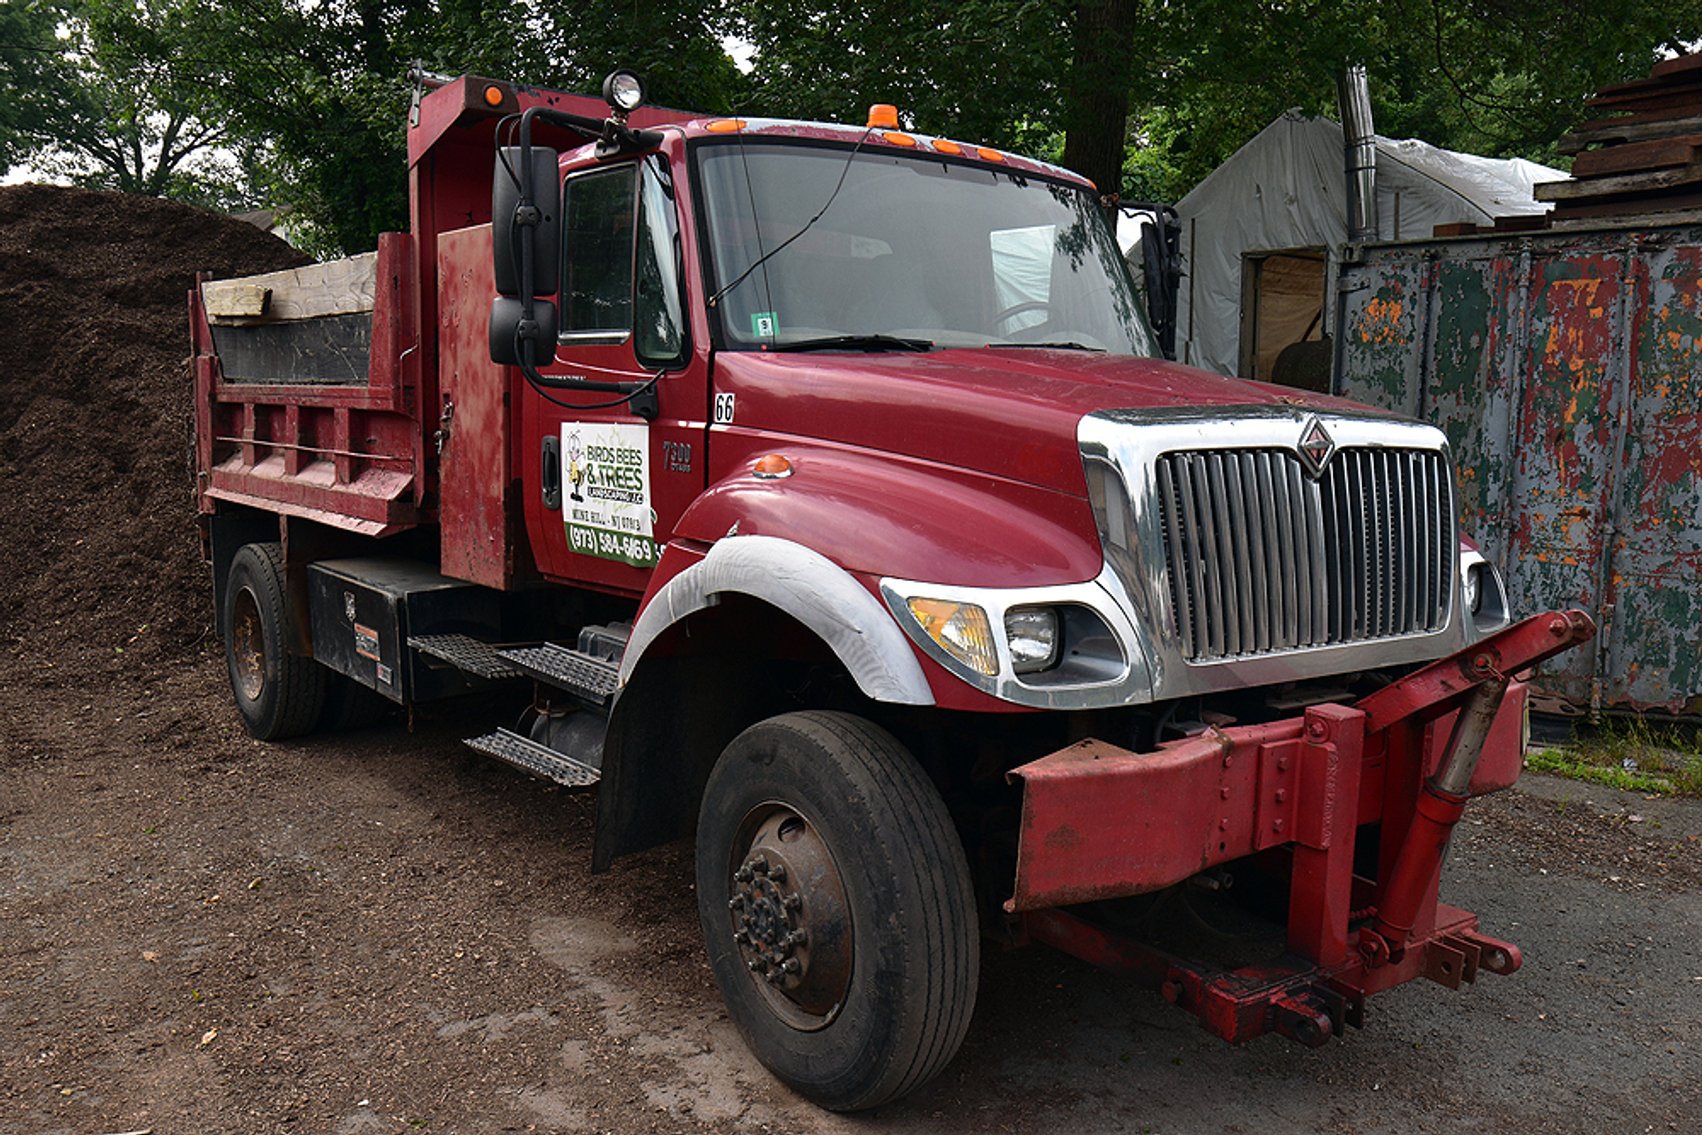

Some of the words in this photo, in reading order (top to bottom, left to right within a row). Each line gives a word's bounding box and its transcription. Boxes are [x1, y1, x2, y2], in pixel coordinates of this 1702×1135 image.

[716, 394, 733, 421] 66
[587, 445, 615, 464] BIRDS
[616, 448, 643, 467] BEES
[587, 463, 597, 485] &
[598, 464, 643, 491] TREES
[569, 523, 599, 555] (973)
